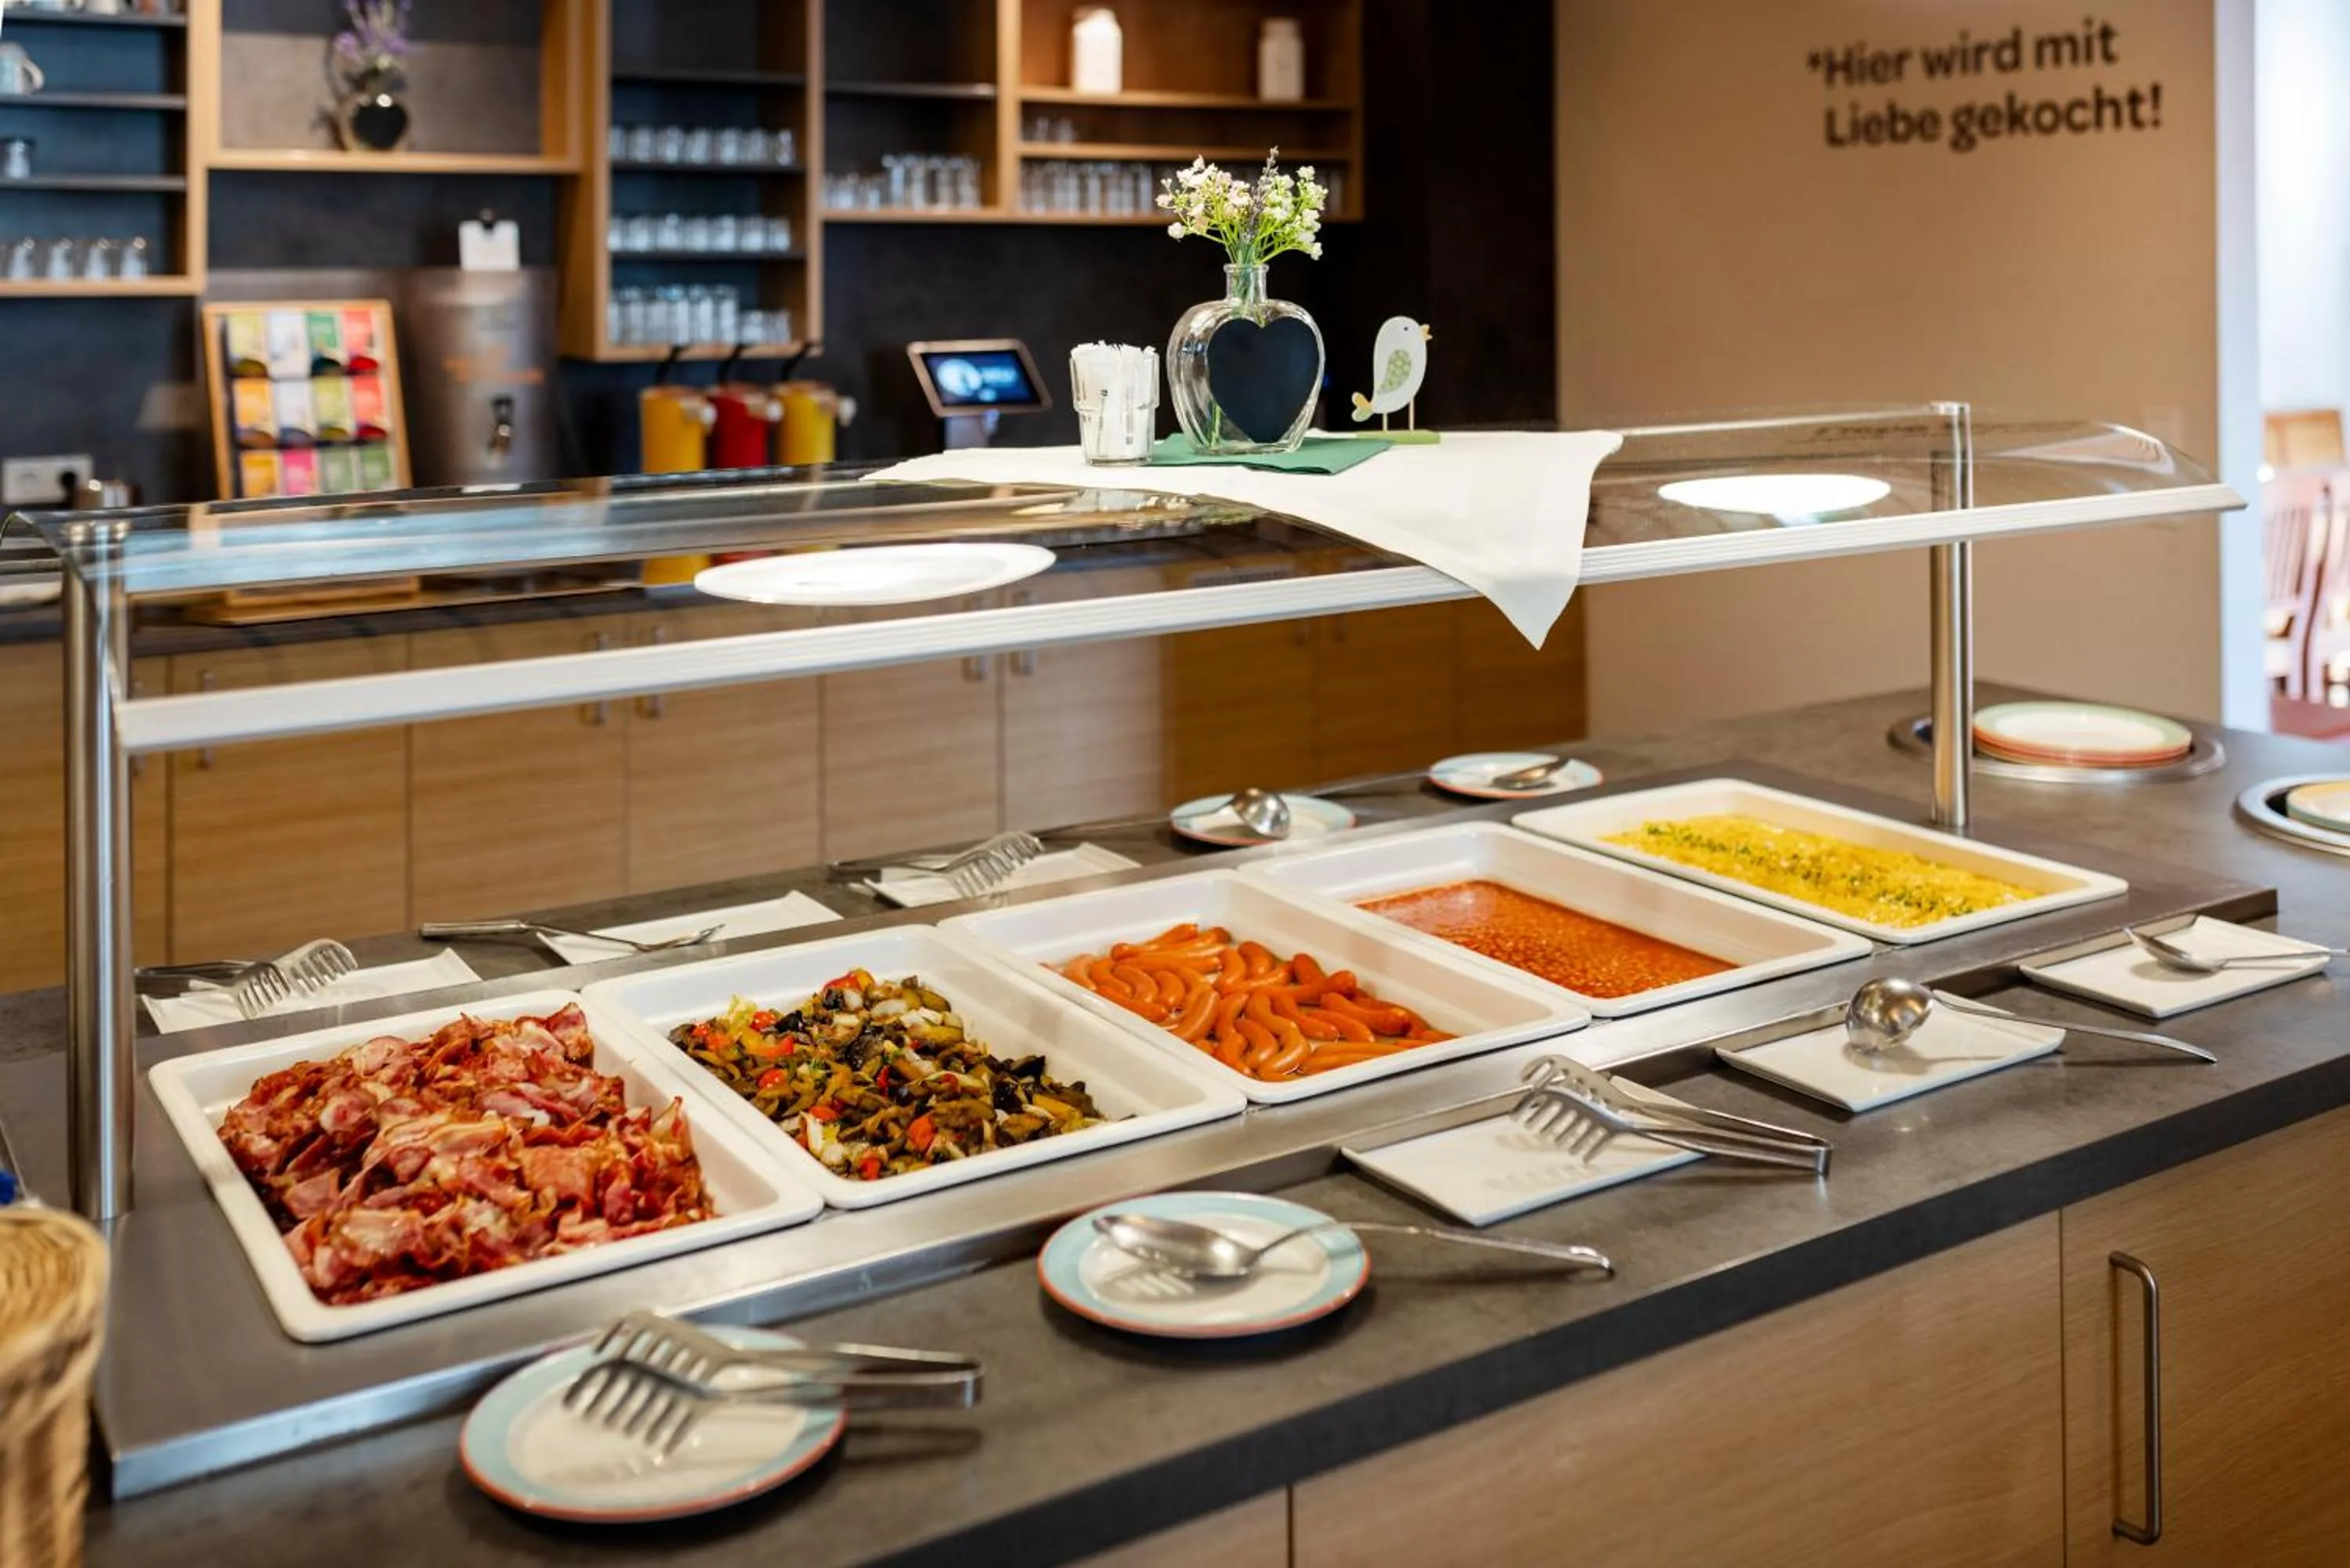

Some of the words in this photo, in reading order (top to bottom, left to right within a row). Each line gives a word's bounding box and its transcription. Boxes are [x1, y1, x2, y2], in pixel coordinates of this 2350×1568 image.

[1921, 26, 2023, 80] wird
[2034, 16, 2119, 70] mit
[1824, 99, 1943, 148] Liebe
[1949, 81, 2163, 154] gekocht!
